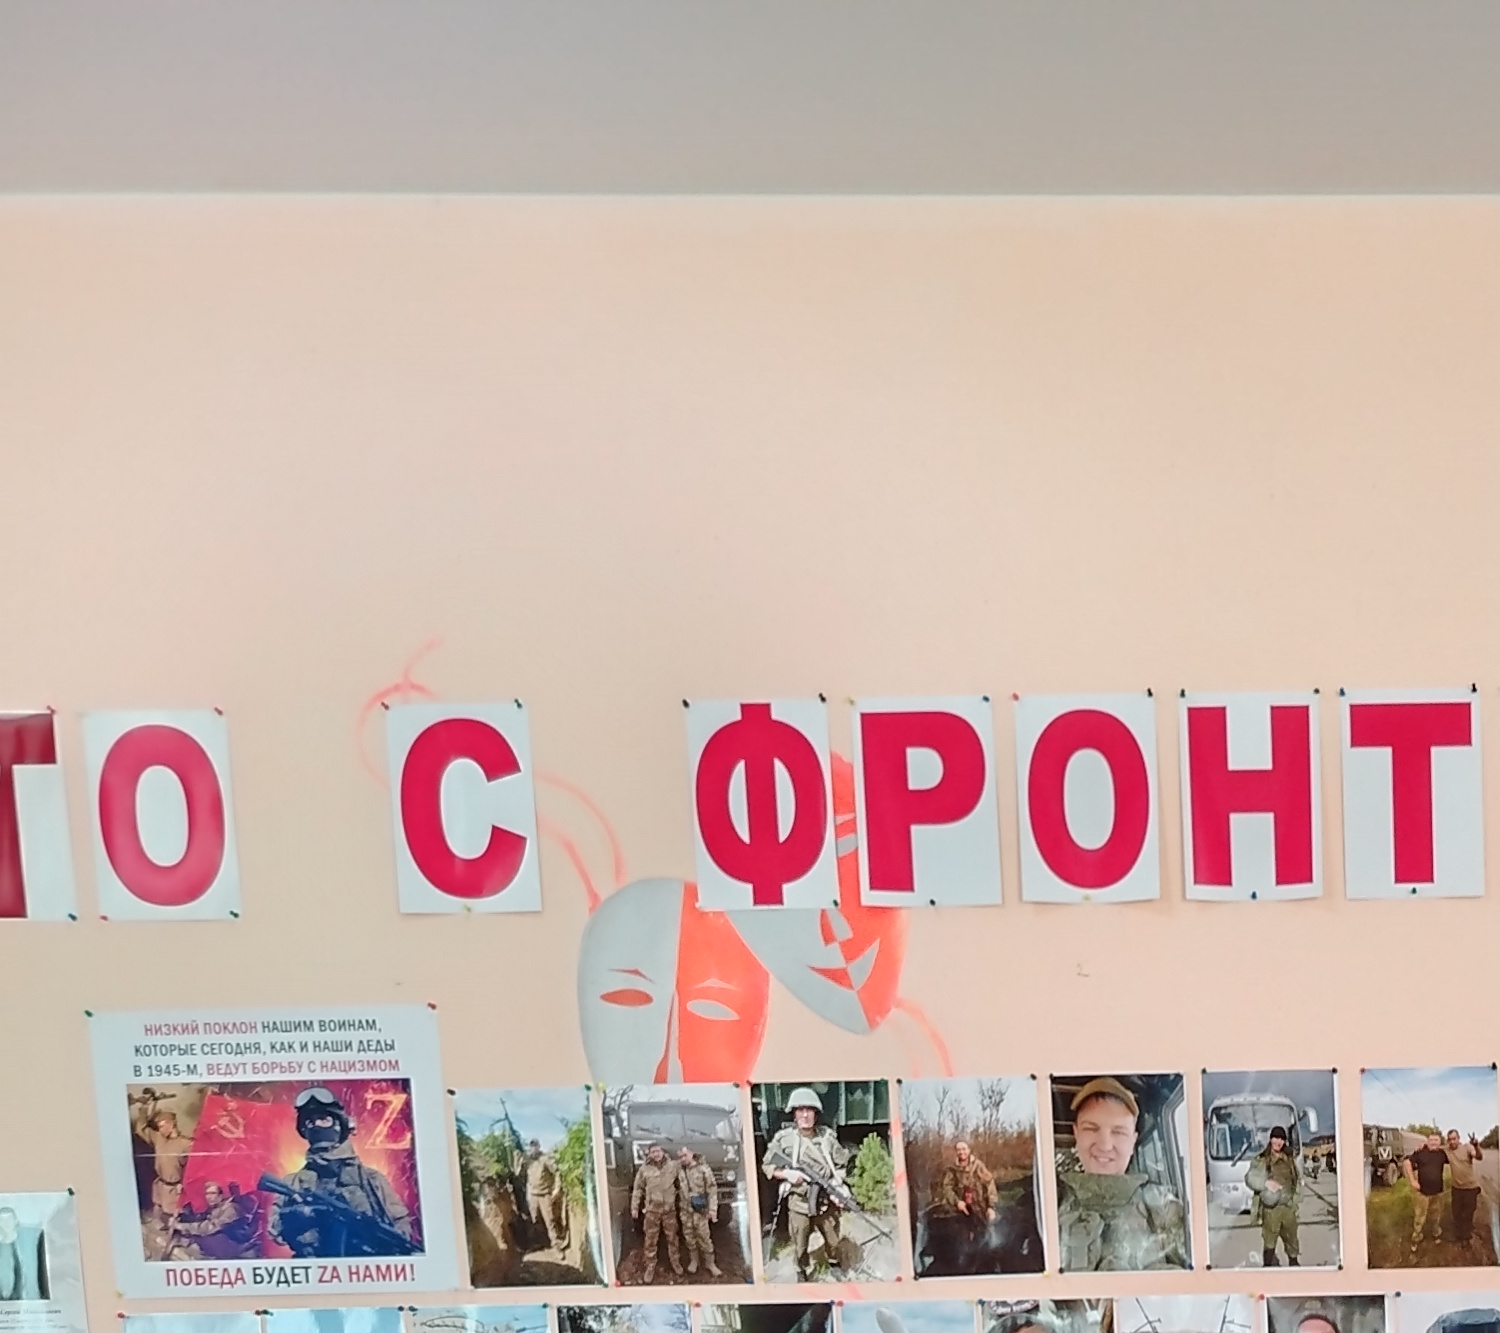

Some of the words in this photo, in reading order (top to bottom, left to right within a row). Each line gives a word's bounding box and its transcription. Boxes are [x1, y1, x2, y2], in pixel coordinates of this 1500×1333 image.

[400, 717, 529, 900] С
[144, 1020, 200, 1036] НИЗКИЙ
[203, 1020, 257, 1035] ПОКЛОН
[262, 1019, 314, 1034] НАШИМ
[319, 1018, 382, 1034] ВОИНАМ,
[134, 1043, 197, 1057] КОТОРЫЕ
[201, 1041, 267, 1057] СЕГОДНЯ,
[270, 1041, 296, 1055] КАК
[299, 1040, 309, 1053] И
[313, 1040, 354, 1053] НАШИ
[357, 1038, 396, 1054] ДЕДЫ
[133, 1065, 143, 1078] В
[147, 1063, 204, 1078] 1945-М,
[207, 1062, 248, 1077] ВЕДУТ
[252, 1060, 304, 1075] БОРЬБУ
[307, 1060, 317, 1074] С
[320, 1059, 400, 1075] НАЦИЗМОМ
[364, 1092, 412, 1150] Z
[166, 1267, 246, 1288] ПОБЕДА
[252, 1265, 312, 1287] БУДЕТ
[348, 1263, 416, 1283] НАМИ!
